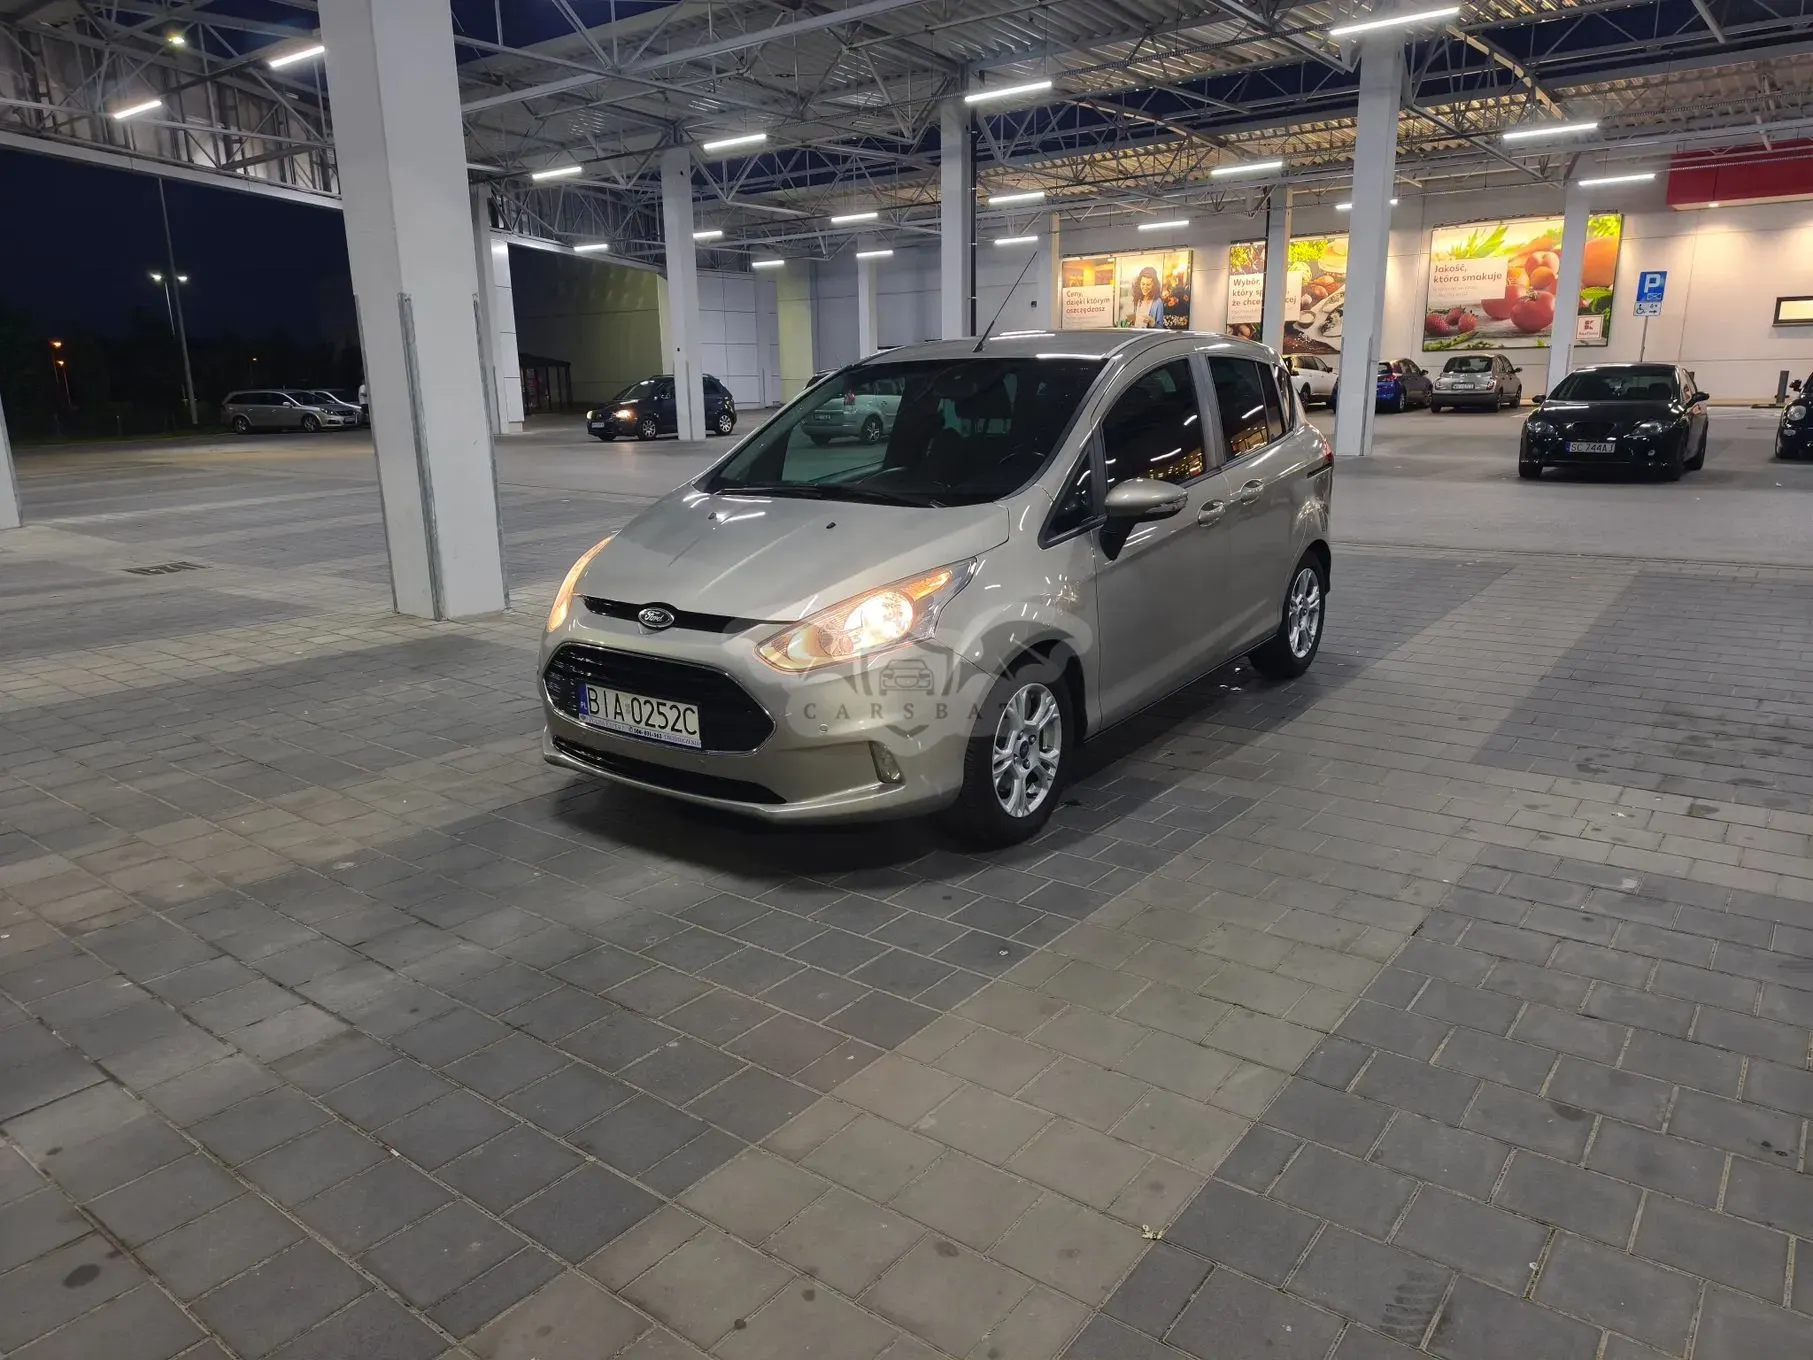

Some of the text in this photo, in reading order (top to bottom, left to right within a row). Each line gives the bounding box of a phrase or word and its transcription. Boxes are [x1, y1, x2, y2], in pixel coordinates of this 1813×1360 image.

[1434, 263, 1467, 273] Jakość,
[1233, 278, 1262, 287] Wybór,
[1433, 272, 1503, 284] która smakuje
[1644, 273, 1661, 293] P
[1066, 290, 1084, 300] Ceny,
[1232, 289, 1254, 298] który
[1066, 297, 1111, 308] dzięki którym
[1243, 297, 1261, 306] chce
[1065, 305, 1106, 315] oszczędzasz
[644, 610, 665, 622] Ford
[586, 687, 698, 736] BIA 0252C
